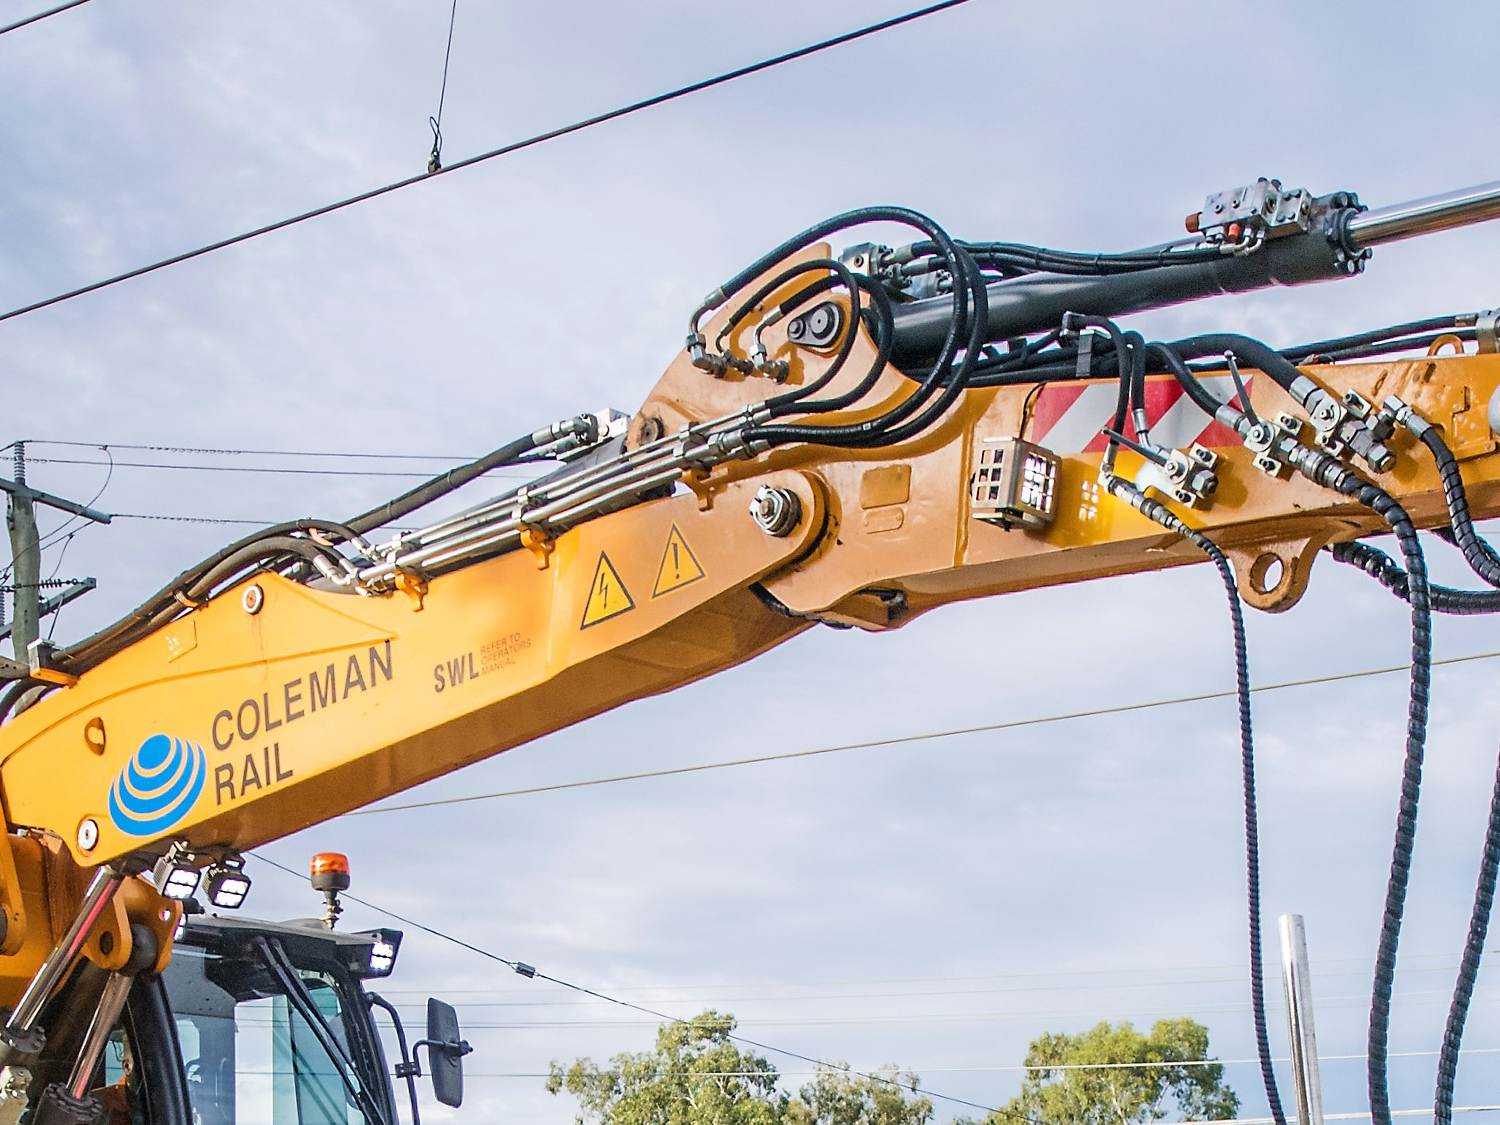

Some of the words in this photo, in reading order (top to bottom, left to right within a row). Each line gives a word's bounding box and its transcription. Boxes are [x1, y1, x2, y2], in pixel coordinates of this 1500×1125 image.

[481, 637, 507, 654] REFER
[509, 632, 521, 644] TO
[481, 638, 532, 666] OPERATORS
[434, 652, 480, 694] SWL
[481, 656, 517, 676] MANUAL
[211, 639, 394, 752] COLEMAN
[215, 742, 295, 806] RAIL
